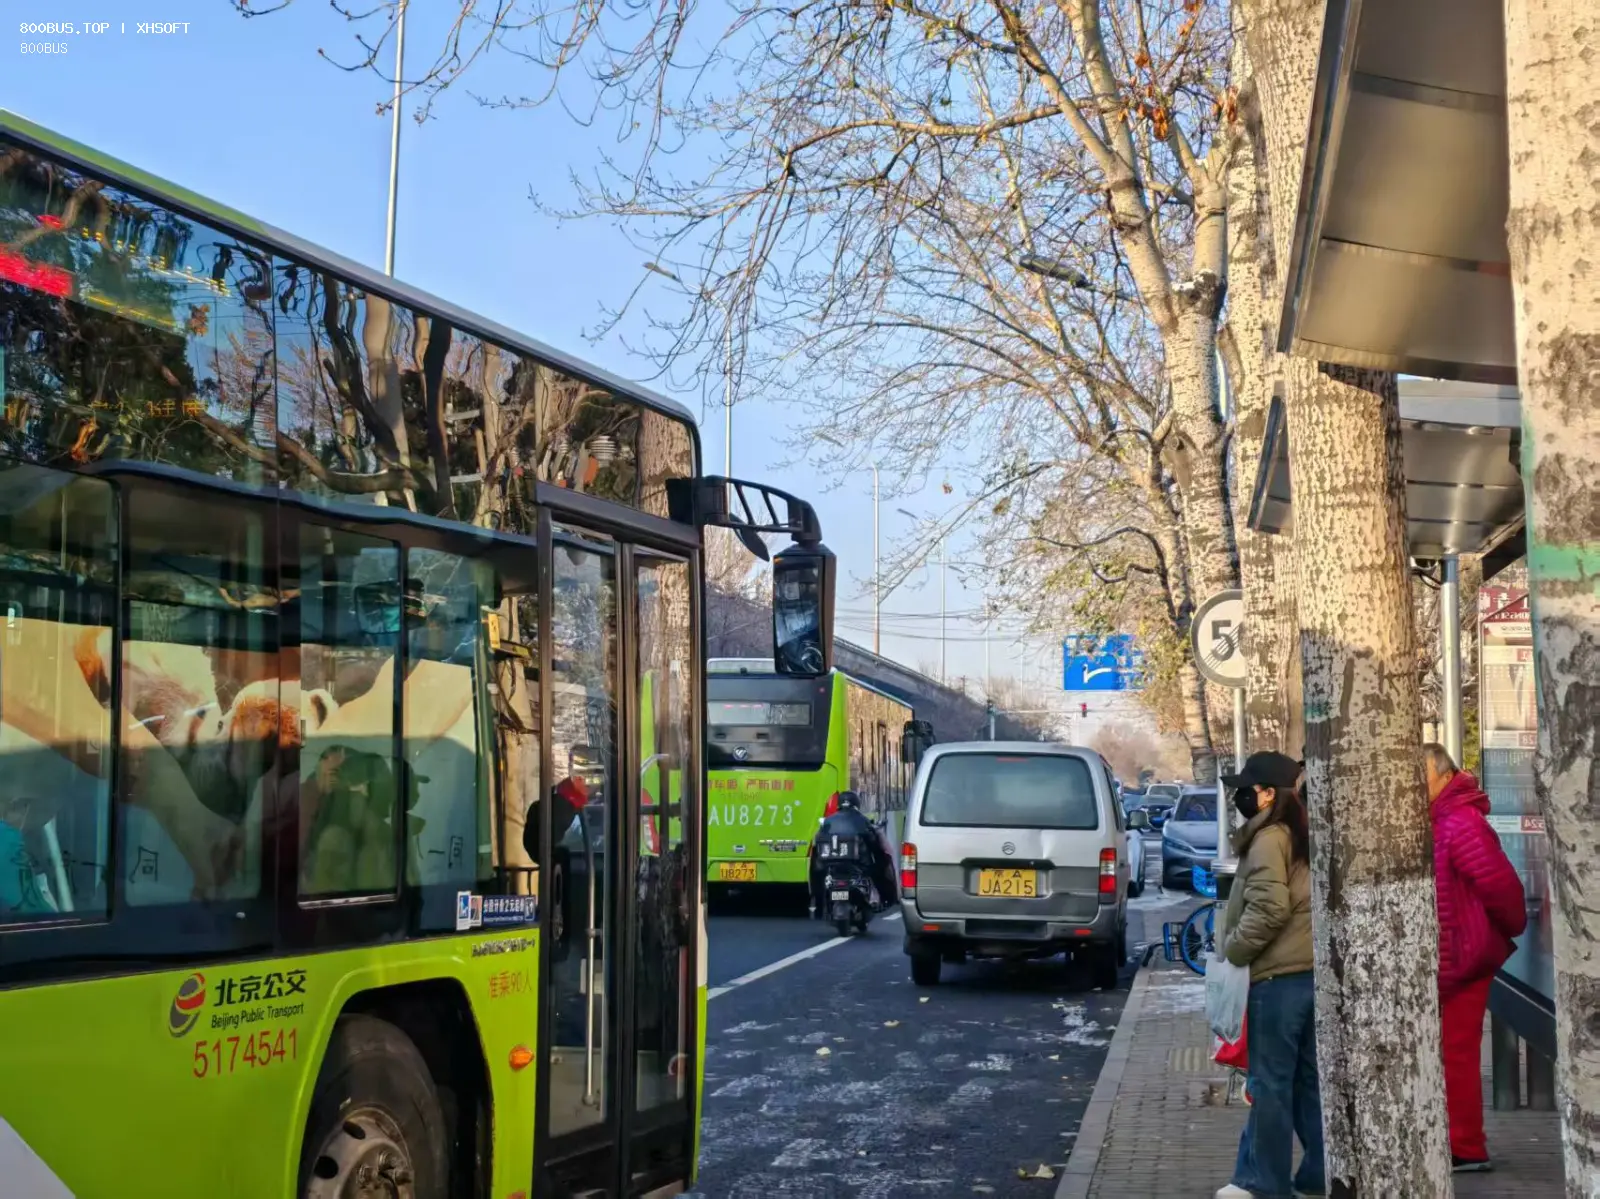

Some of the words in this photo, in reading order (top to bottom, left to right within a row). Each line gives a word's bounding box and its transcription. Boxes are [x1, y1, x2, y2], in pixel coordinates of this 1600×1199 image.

[708, 804, 793, 826] AU8273
[982, 879, 1034, 895] JA215
[213, 969, 307, 1007] 北京公交
[211, 1012, 240, 1030] Beijing
[241, 1009, 264, 1025] Public
[267, 1003, 304, 1020] Transport
[193, 1027, 297, 1079] 5174541
